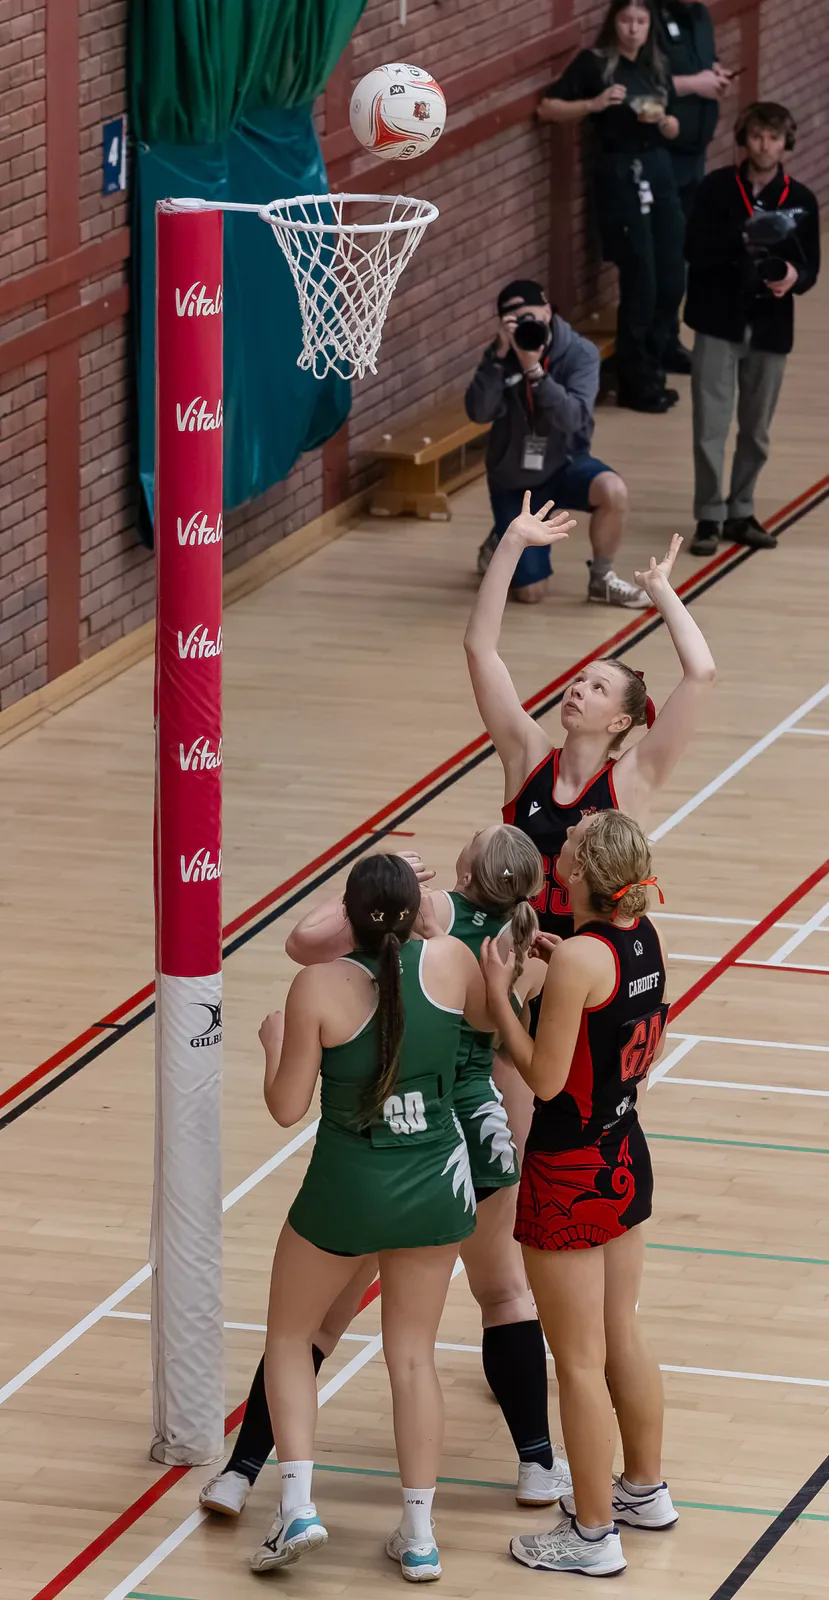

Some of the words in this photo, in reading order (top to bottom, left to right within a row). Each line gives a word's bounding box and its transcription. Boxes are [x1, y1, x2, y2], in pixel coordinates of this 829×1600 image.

[391, 86, 404, 94] VK
[108, 136, 119, 167] 4
[180, 847, 222, 883] Vital
[629, 971, 660, 998] CARDIFF
[621, 1012, 661, 1082] GA
[383, 1091, 428, 1135] GD
